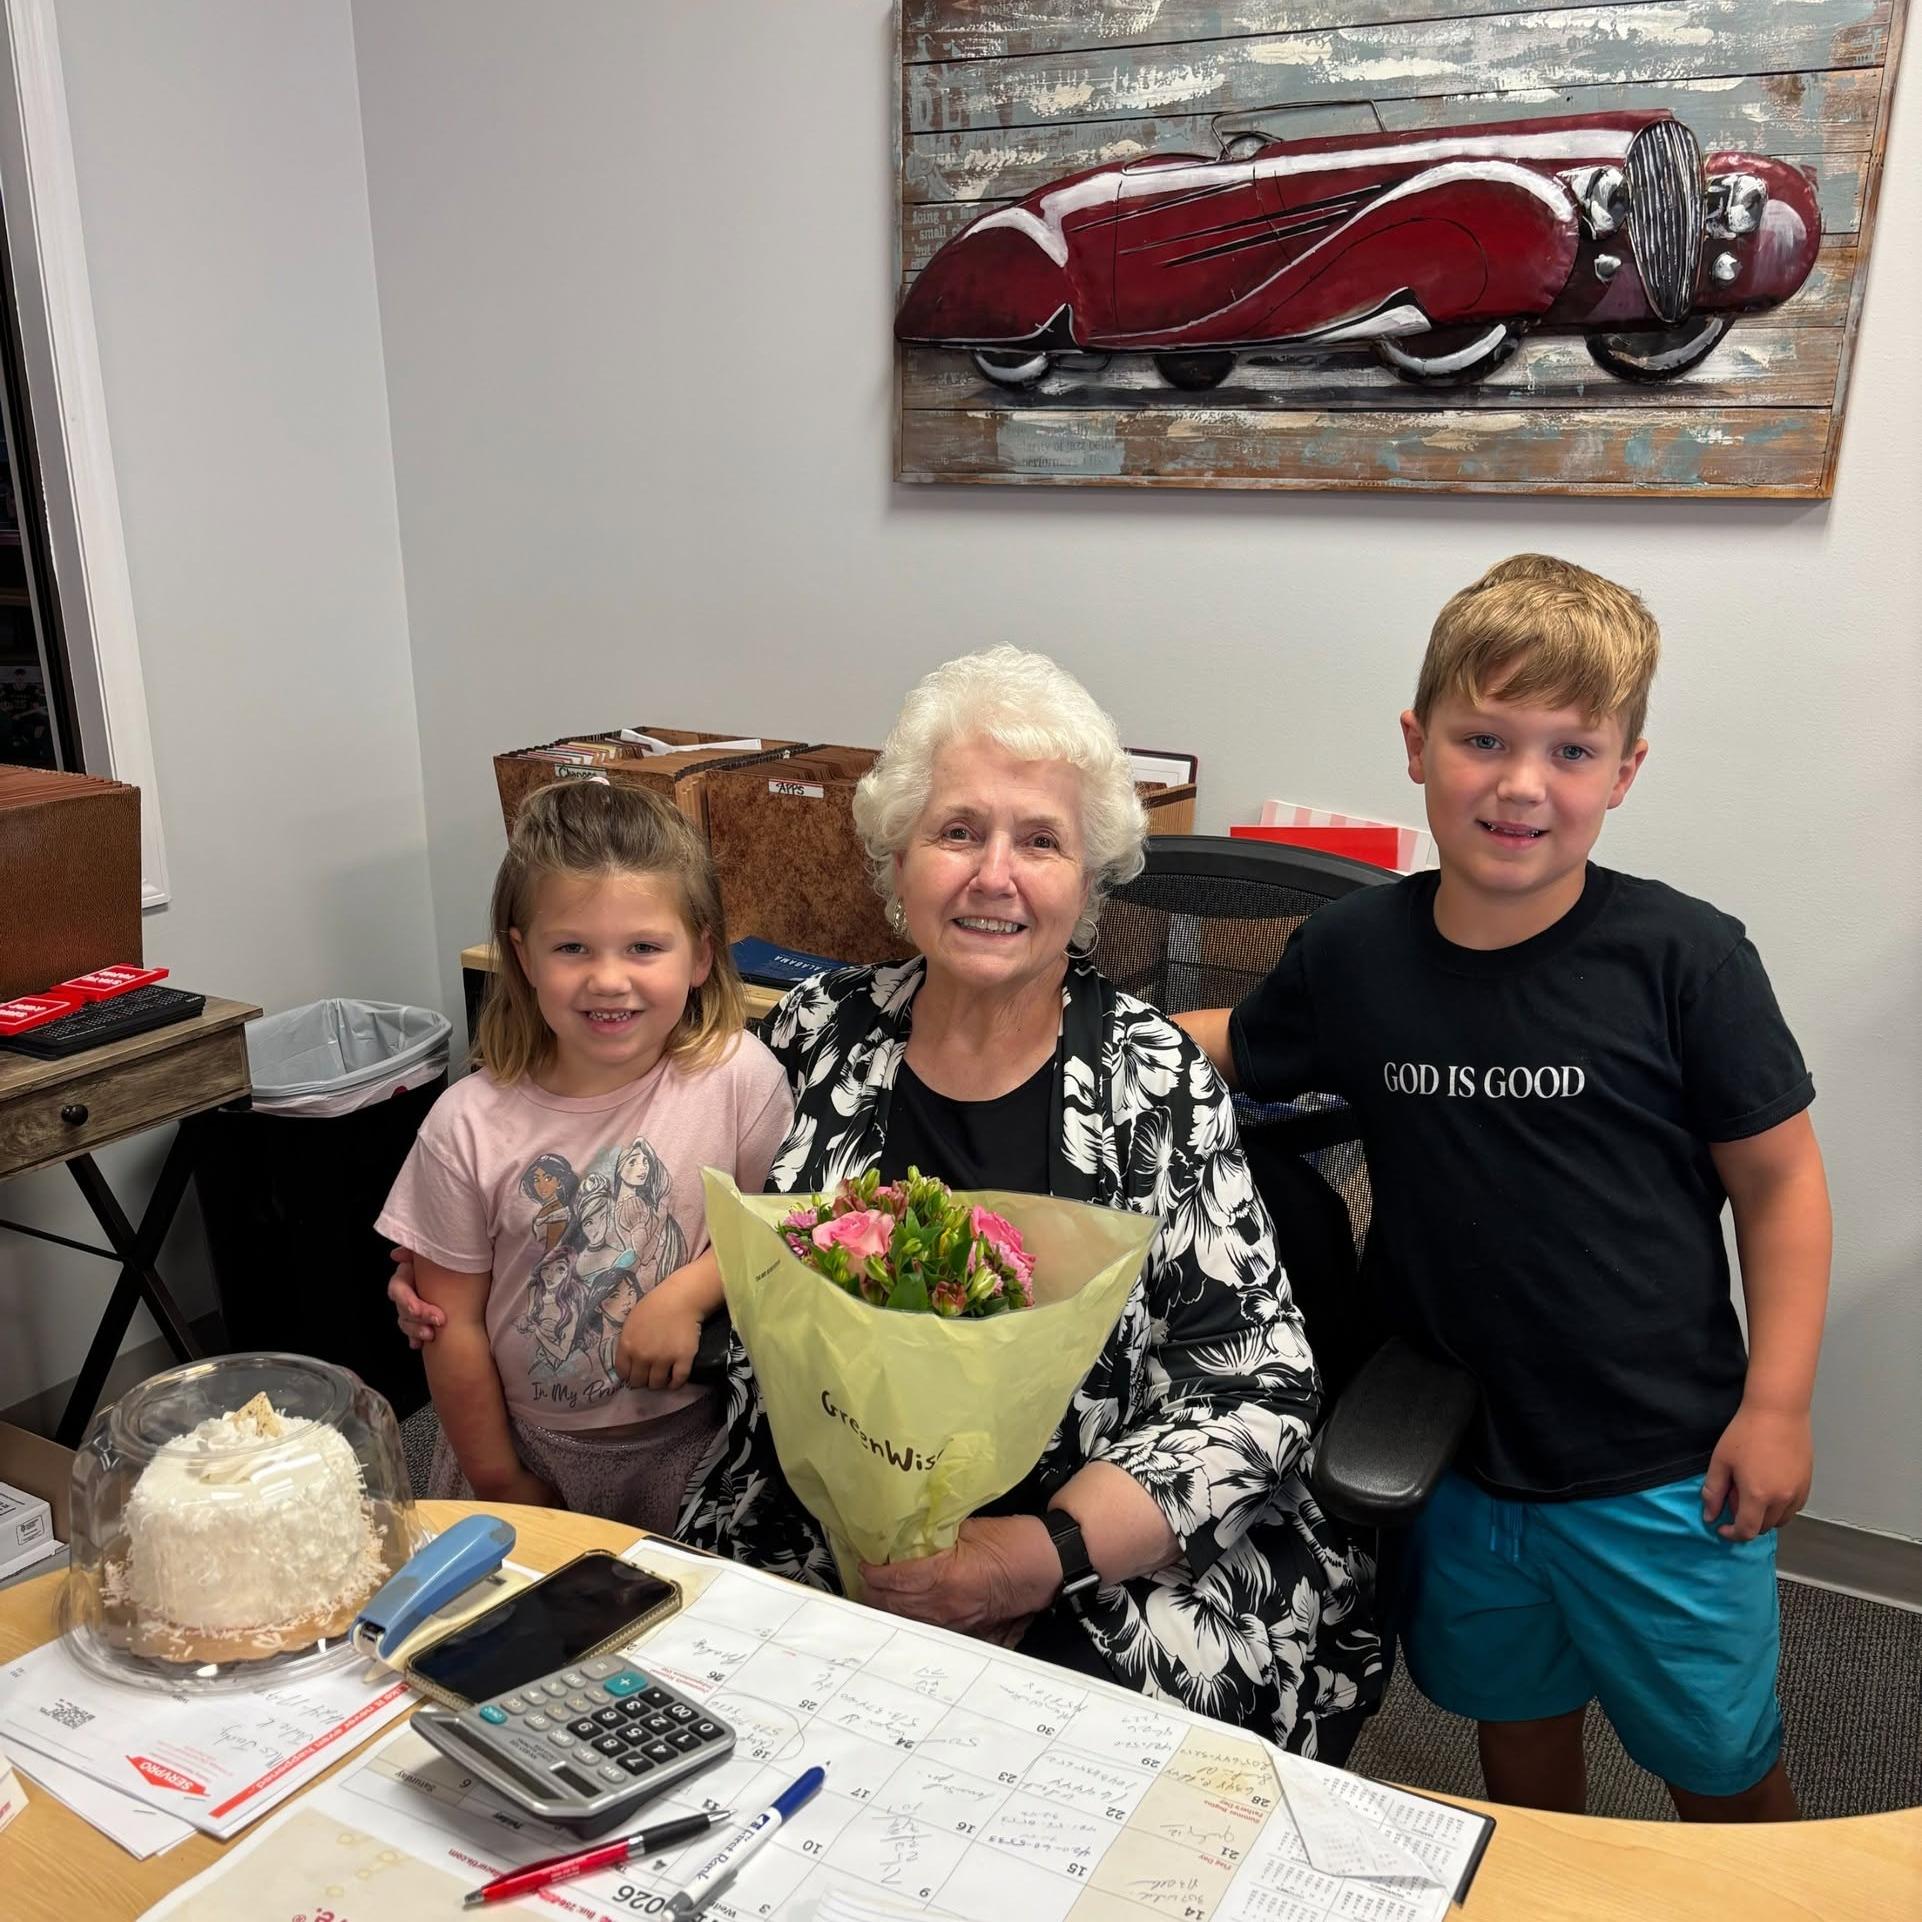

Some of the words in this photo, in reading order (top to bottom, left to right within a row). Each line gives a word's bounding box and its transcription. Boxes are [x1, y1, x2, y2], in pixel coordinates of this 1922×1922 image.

[775, 781, 805, 796] APPS
[774, 955, 823, 971] ALABAMA
[1384, 1062, 1440, 1095] GOD
[1447, 1065, 1476, 1098] IS
[1483, 1066, 1585, 1098] GOOD
[551, 1383, 577, 1408] My
[821, 1390, 945, 1472] GreenWis
[626, 1700, 641, 1711] 3
[799, 1699, 818, 1711] 25
[602, 1711, 617, 1722] 6
[671, 1705, 691, 1718] 00
[578, 1722, 593, 1733] 9
[651, 1717, 666, 1728] 2
[700, 1722, 714, 1733] 0
[626, 1728, 643, 1739] 5
[1036, 1723, 1055, 1736] 30
[603, 1738, 618, 1749] 8
[676, 1734, 691, 1744] 1
[893, 1737, 915, 1749] 24
[652, 1744, 667, 1754] 4
[752, 1748, 771, 1759] 18
[627, 1758, 643, 1768] 7
[1141, 1757, 1161, 1769] 29
[139, 1762, 194, 1791] SERVPRO
[395, 1769, 437, 1793] Saturday
[997, 1771, 1018, 1784] 23
[459, 1778, 472, 1790] 6
[851, 1787, 871, 1799] 17
[1251, 1795, 1272, 1808] 28
[1105, 1806, 1126, 1820] 22
[955, 1821, 976, 1834] 16
[802, 1839, 823, 1855] 10
[1221, 1846, 1241, 1860] 21
[1066, 1862, 1088, 1877] 15
[918, 1887, 931, 1898] 9
[612, 1885, 667, 1916] 026
[758, 1903, 771, 1914] 3
[1184, 1906, 1205, 1921] 14
